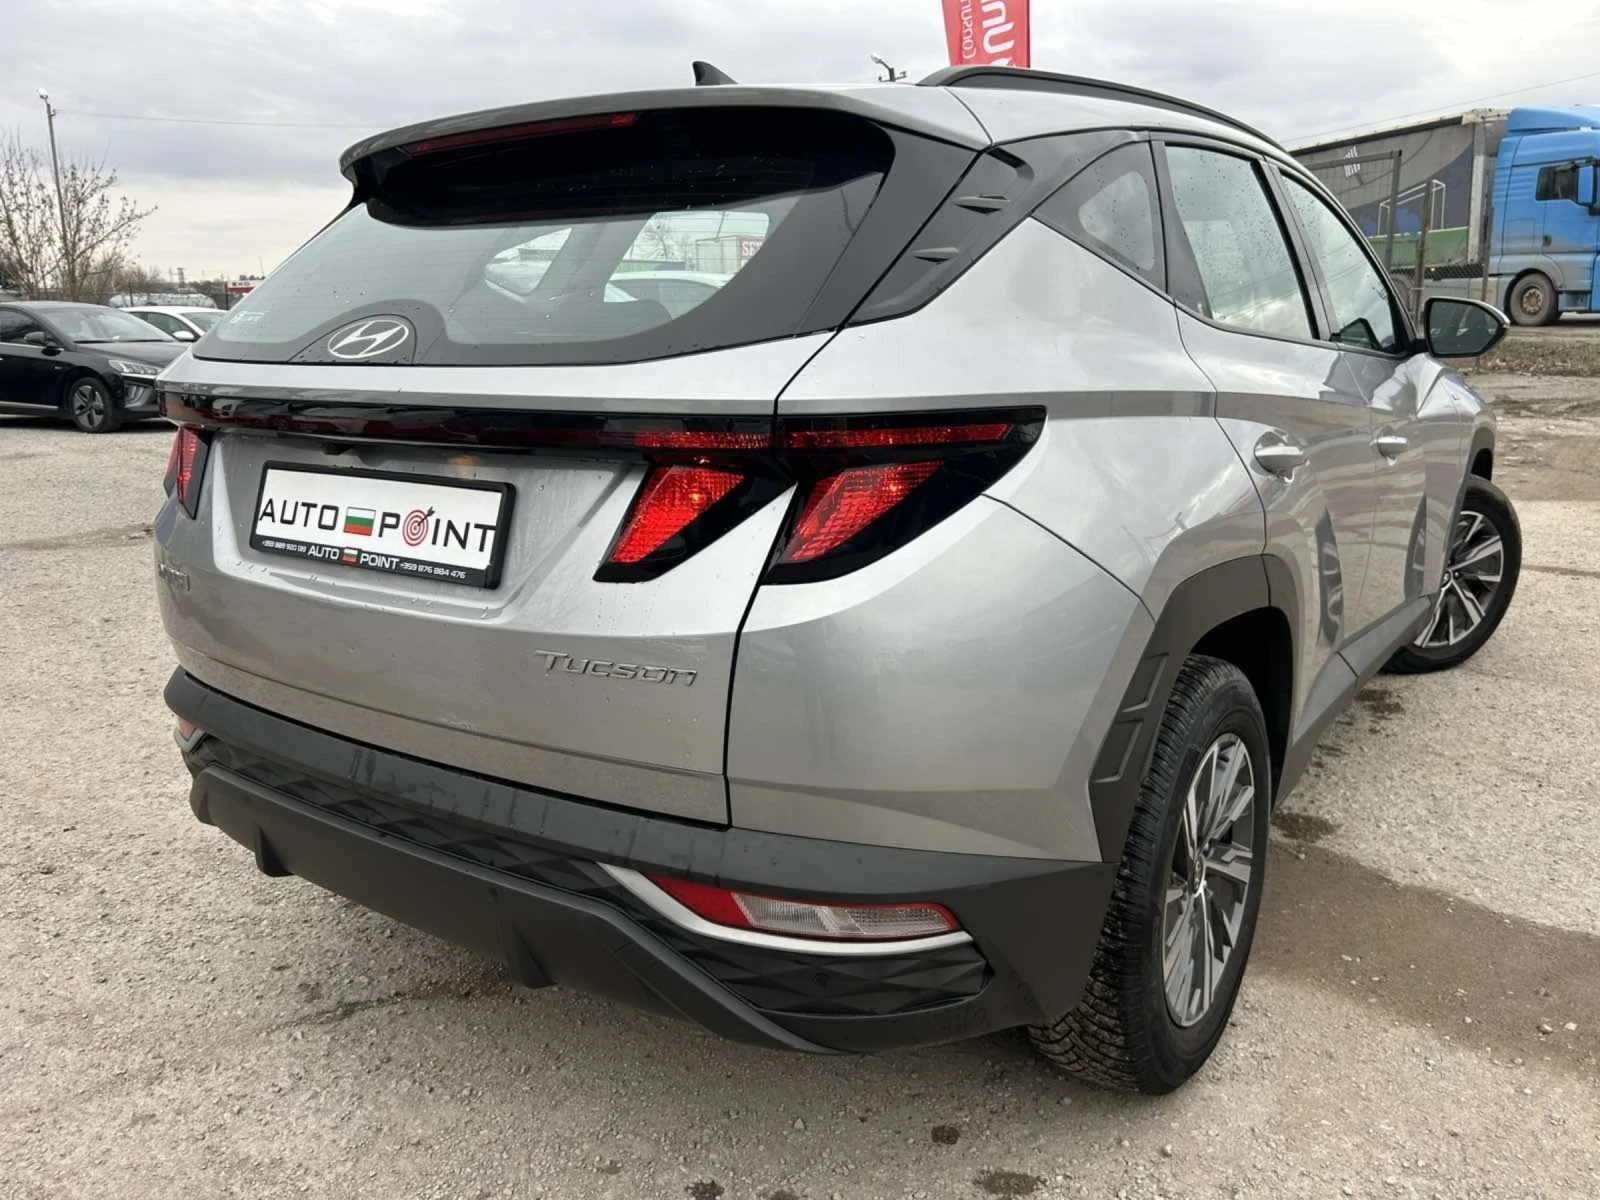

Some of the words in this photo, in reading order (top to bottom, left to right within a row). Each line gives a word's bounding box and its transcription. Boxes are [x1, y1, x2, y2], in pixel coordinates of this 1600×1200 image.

[259, 498, 339, 530] AUTO
[307, 545, 340, 560] AUTO
[360, 553, 399, 570] POINT
[400, 562, 417, 571] +359
